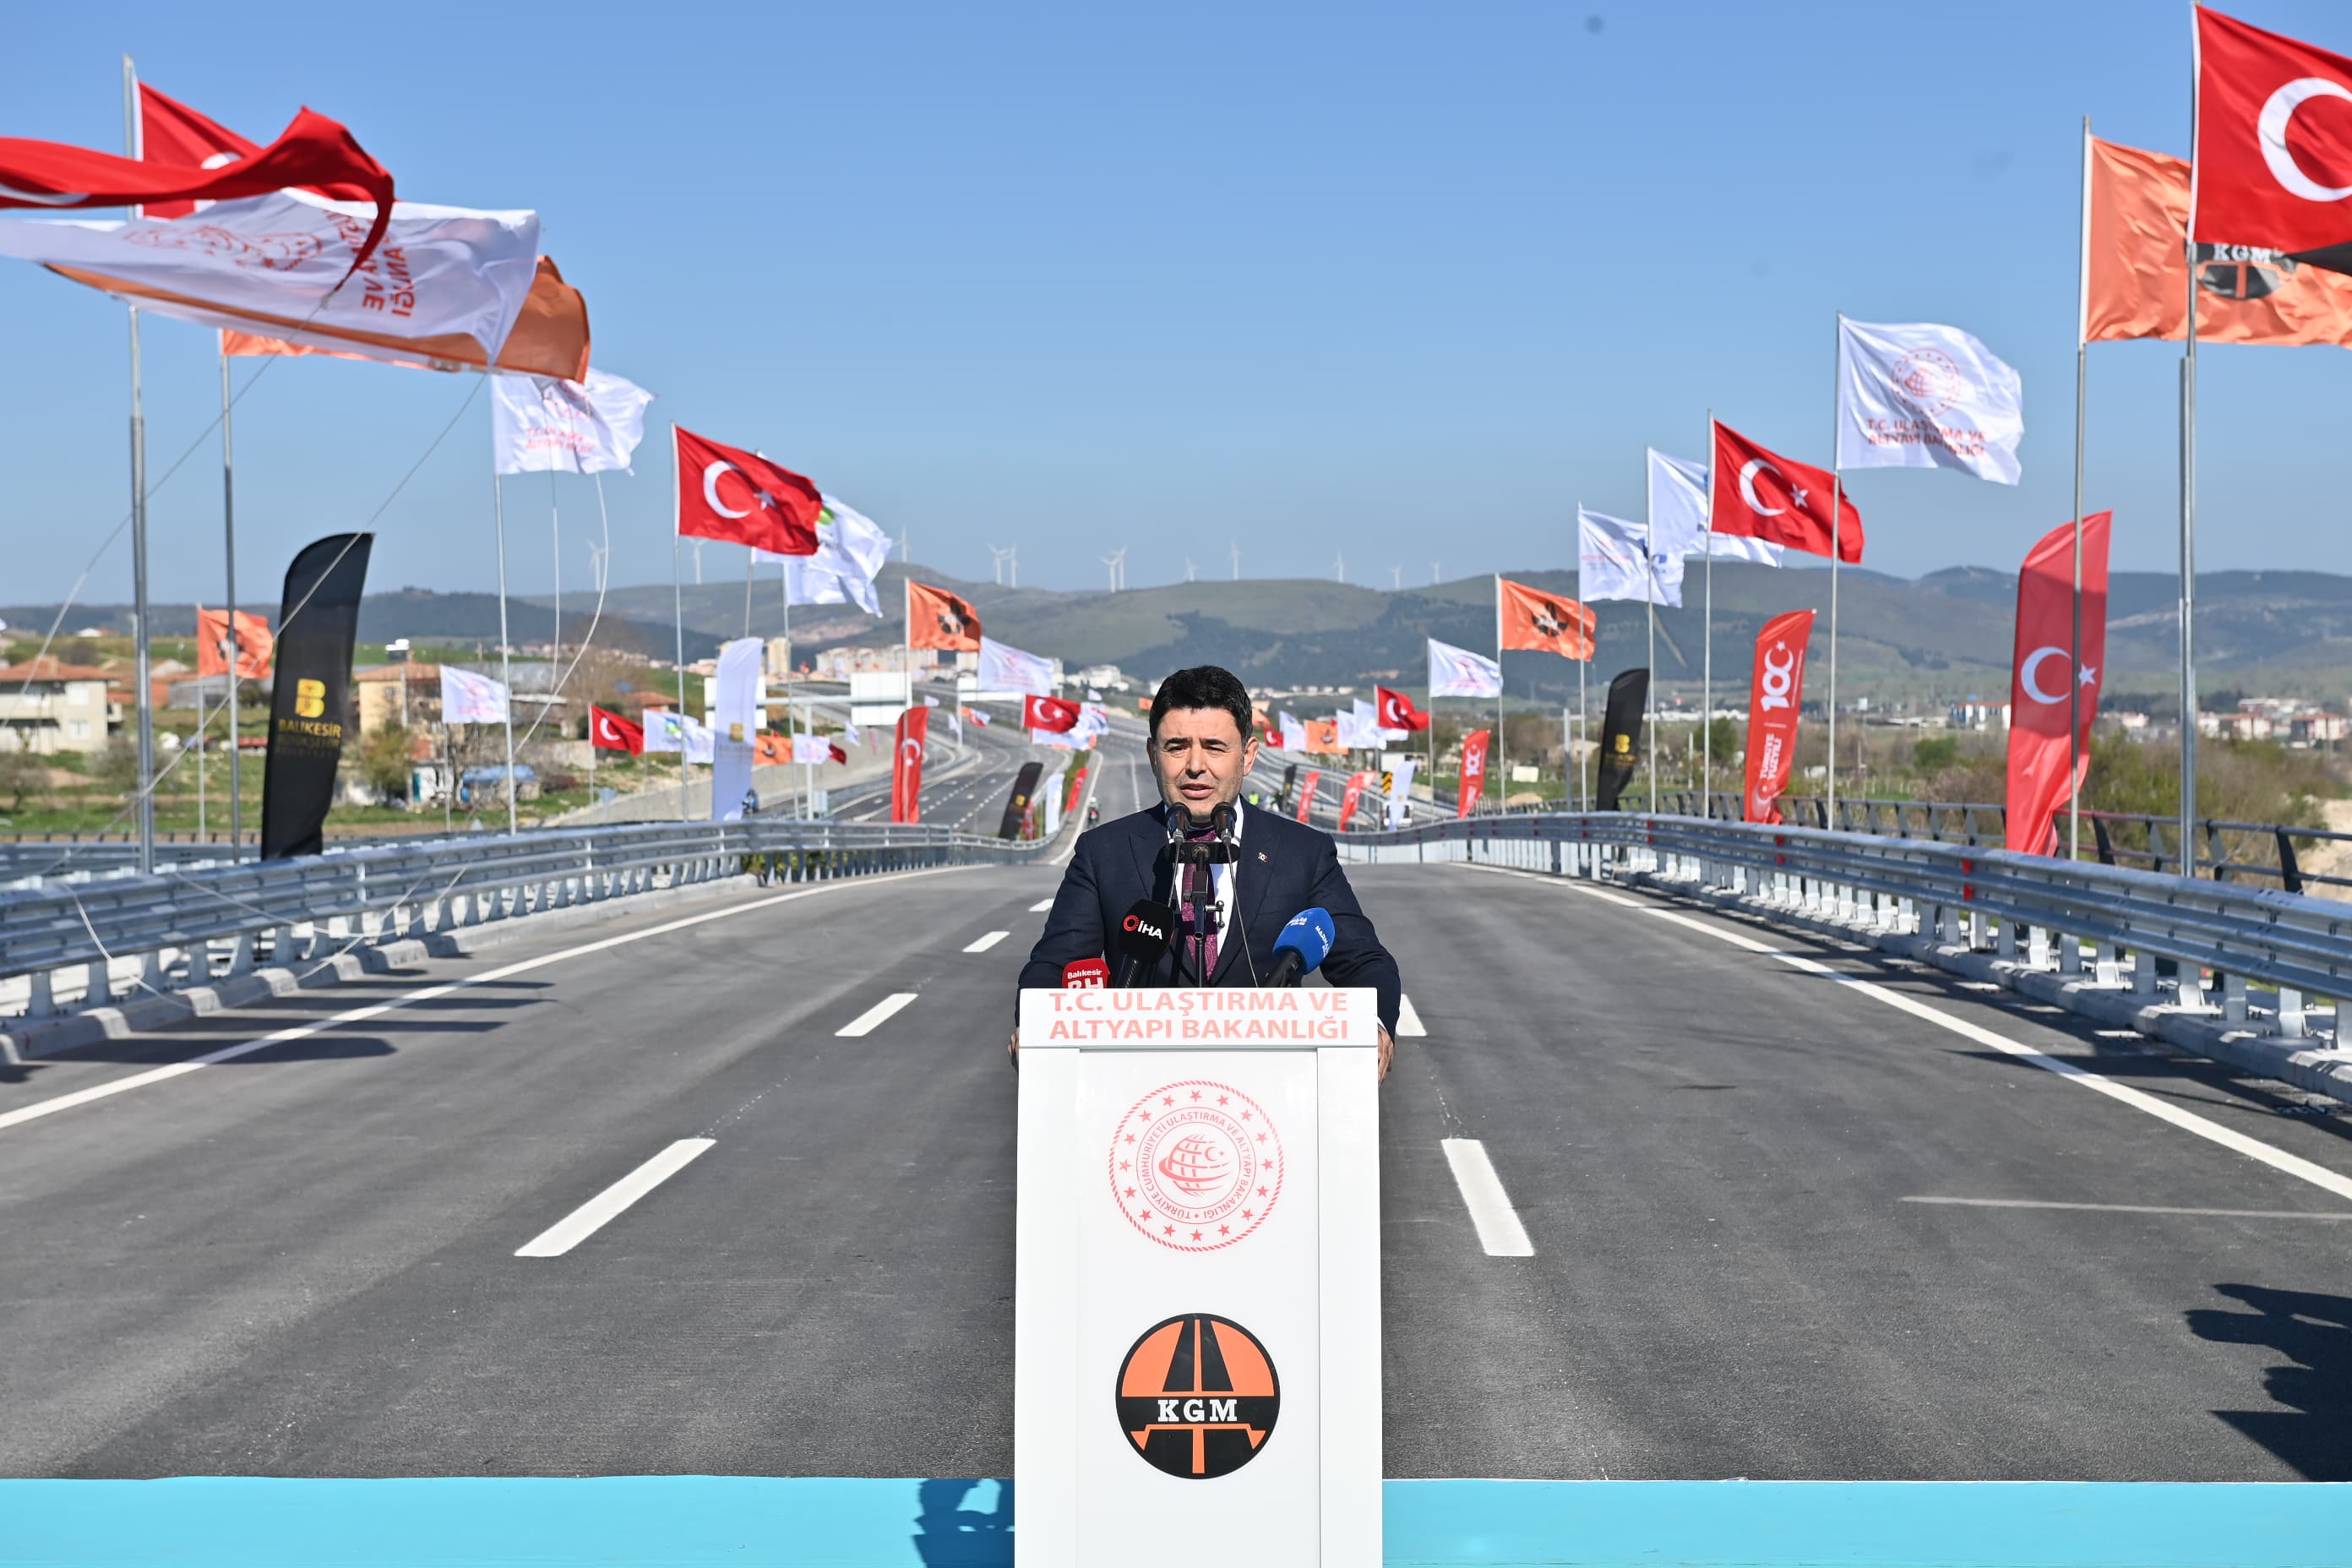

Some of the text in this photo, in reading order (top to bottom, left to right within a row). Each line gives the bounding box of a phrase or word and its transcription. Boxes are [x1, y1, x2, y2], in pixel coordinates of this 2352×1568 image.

[2213, 242, 2272, 264] KGM
[1138, 920, 1162, 939] İHA
[1067, 968, 1102, 979] Balıkesir
[1048, 992, 1348, 1016] T.C. ULAŞTIRMA VE
[1048, 1015, 1348, 1039] ALTYAPI BAKANLIĞI
[1141, 1111, 1252, 1219] TÜRKİYE CUMHURİYETİ ULAŞTIRMA VE ALTYAPI BAKANLIĞI
[1157, 1399, 1238, 1422] KGM
